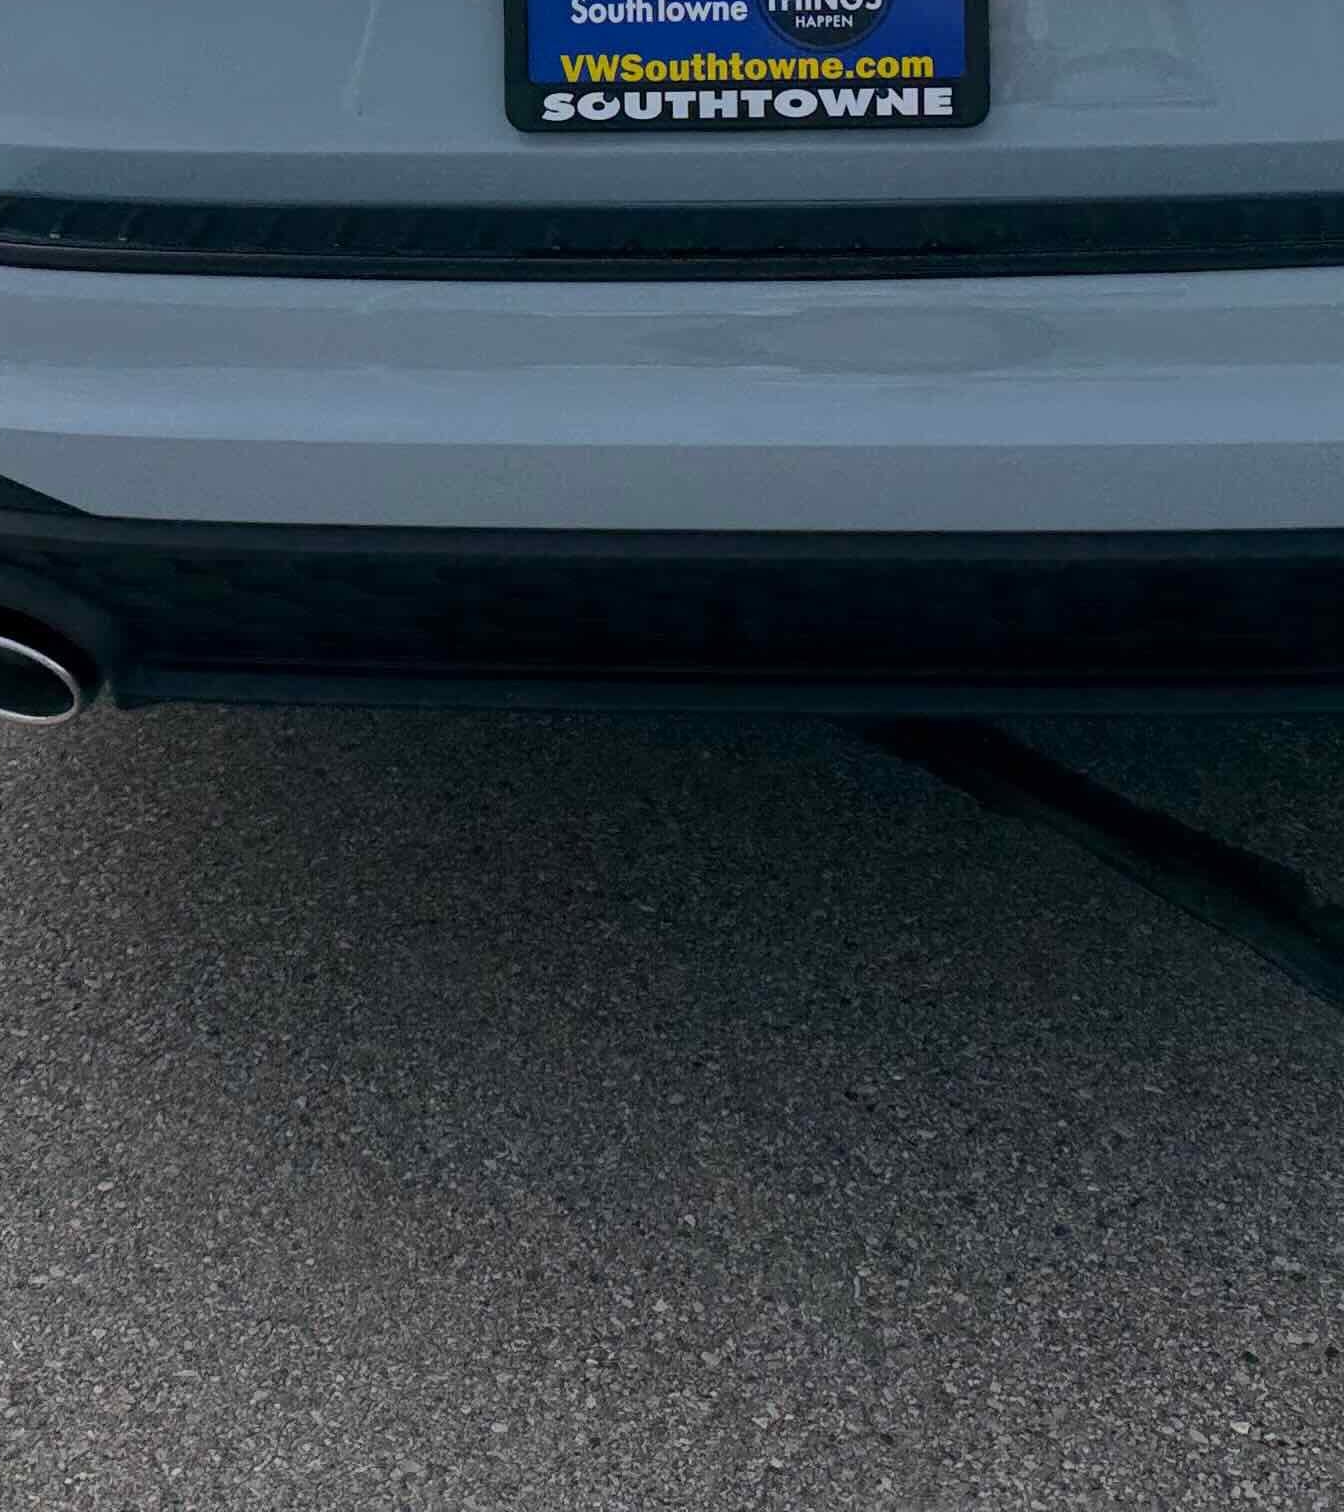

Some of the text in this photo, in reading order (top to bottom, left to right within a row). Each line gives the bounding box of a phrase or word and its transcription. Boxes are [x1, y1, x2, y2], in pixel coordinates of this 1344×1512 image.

[795, 15, 853, 29] HAPPEN
[560, 52, 934, 83] VWSouthtowne.com
[541, 88, 953, 122] SOUTHTOWNE
